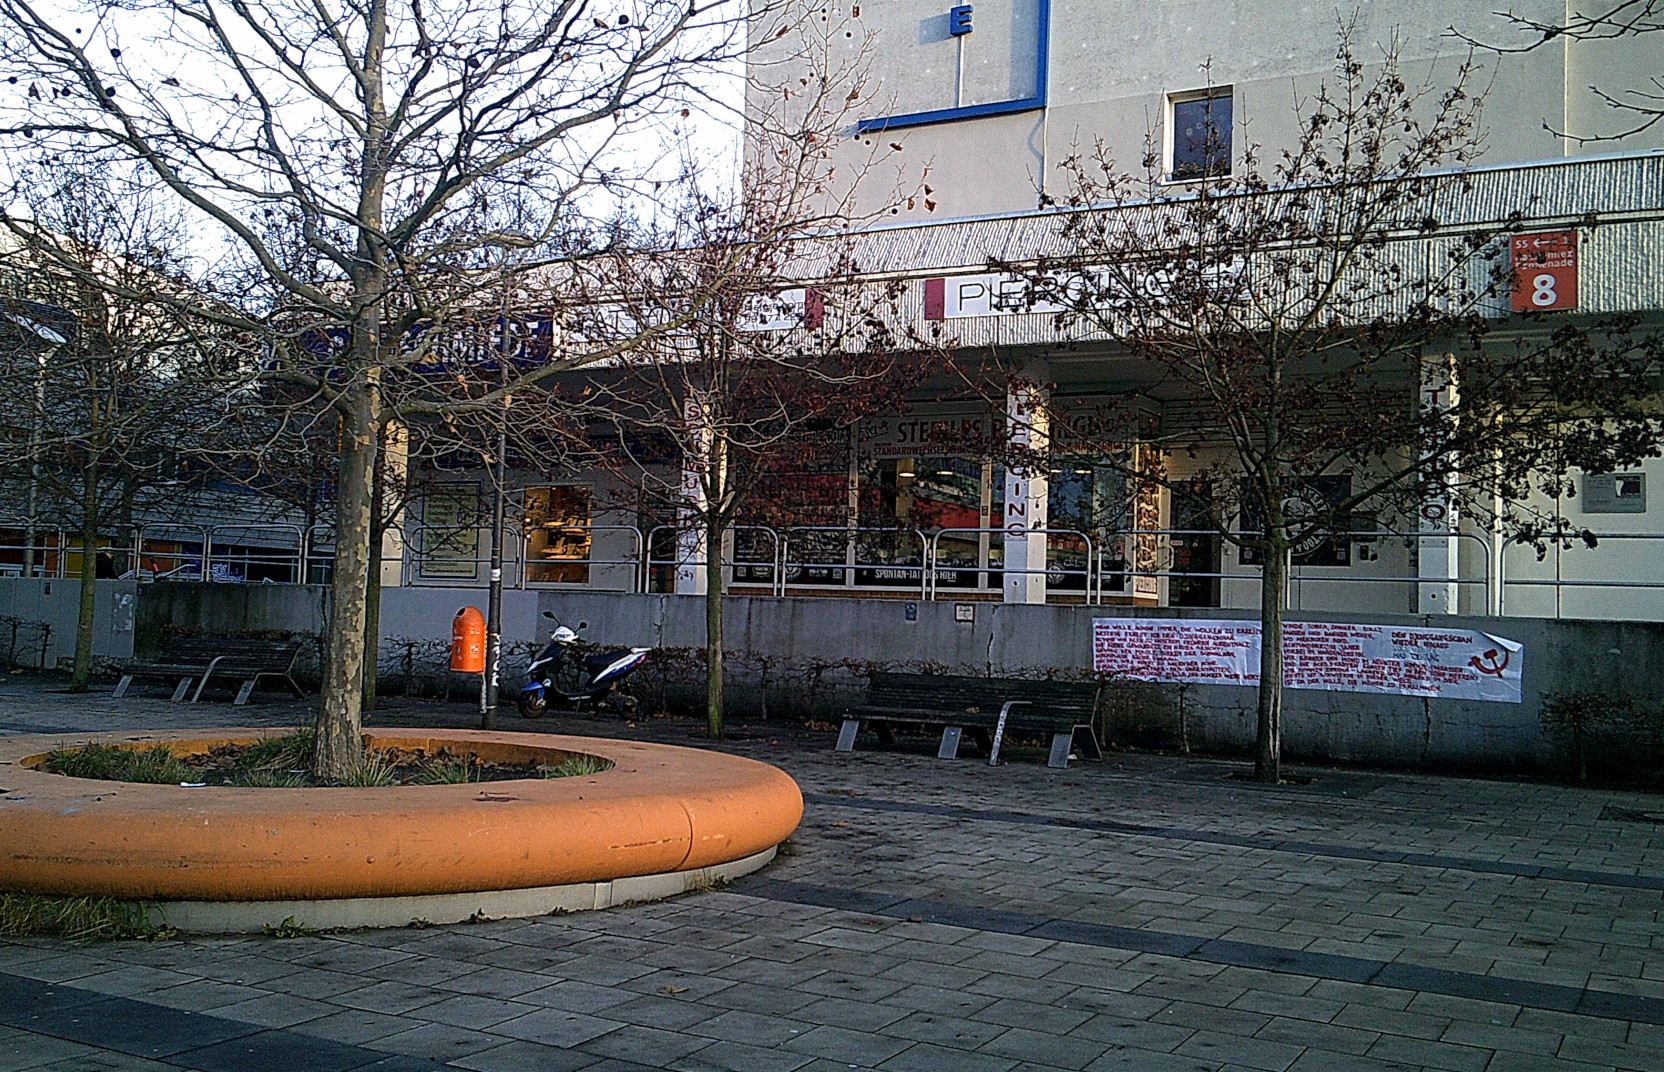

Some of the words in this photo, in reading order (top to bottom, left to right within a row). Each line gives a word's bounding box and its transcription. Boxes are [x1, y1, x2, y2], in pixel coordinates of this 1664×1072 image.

[950, 5, 973, 36] E
[1516, 240, 1528, 248] 55
[1532, 274, 1556, 306] 8
[1006, 381, 1027, 538] IERCING
[875, 569, 938, 580] SPONTAN-TATOS
[940, 570, 957, 580] HIER
